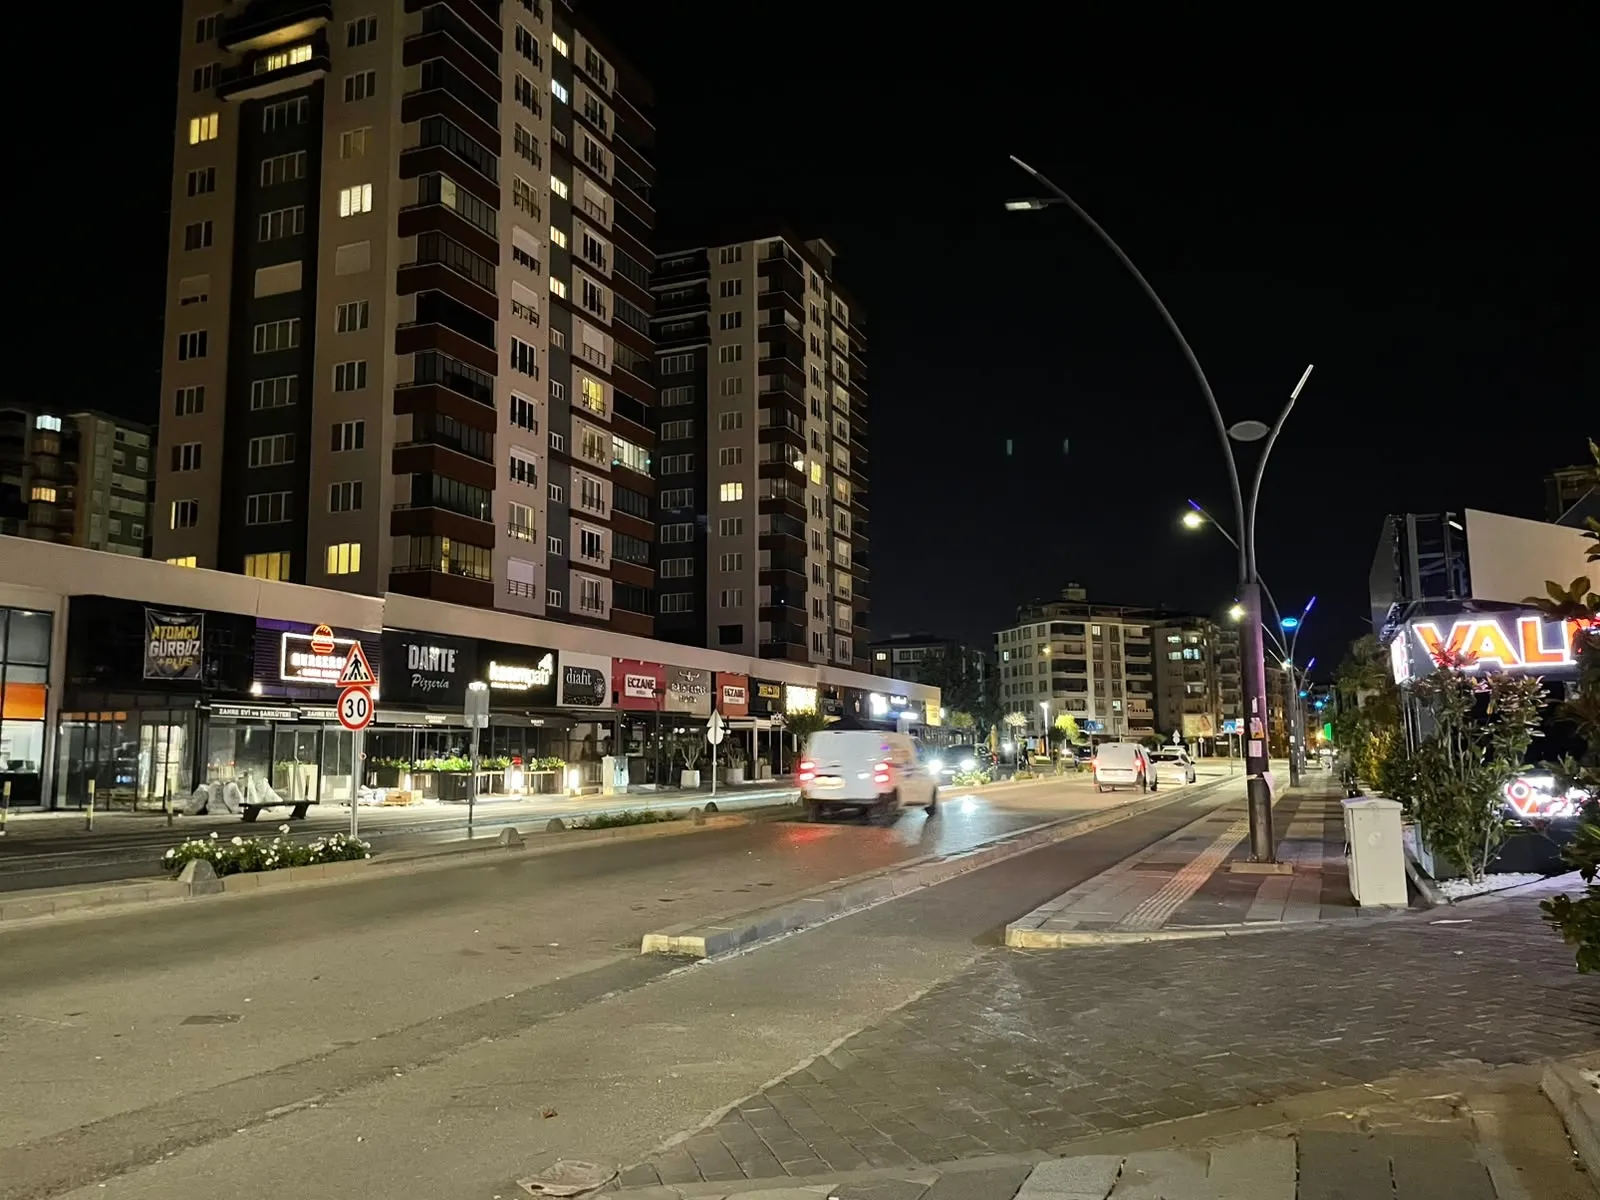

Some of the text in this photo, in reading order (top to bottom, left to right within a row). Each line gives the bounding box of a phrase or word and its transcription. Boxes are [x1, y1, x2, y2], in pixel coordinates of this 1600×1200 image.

[408, 644, 456, 673] DANTE
[411, 673, 449, 692] Pizzeria
[566, 667, 592, 686] diafit
[627, 677, 655, 690] ECZANE
[345, 698, 367, 718] 30
